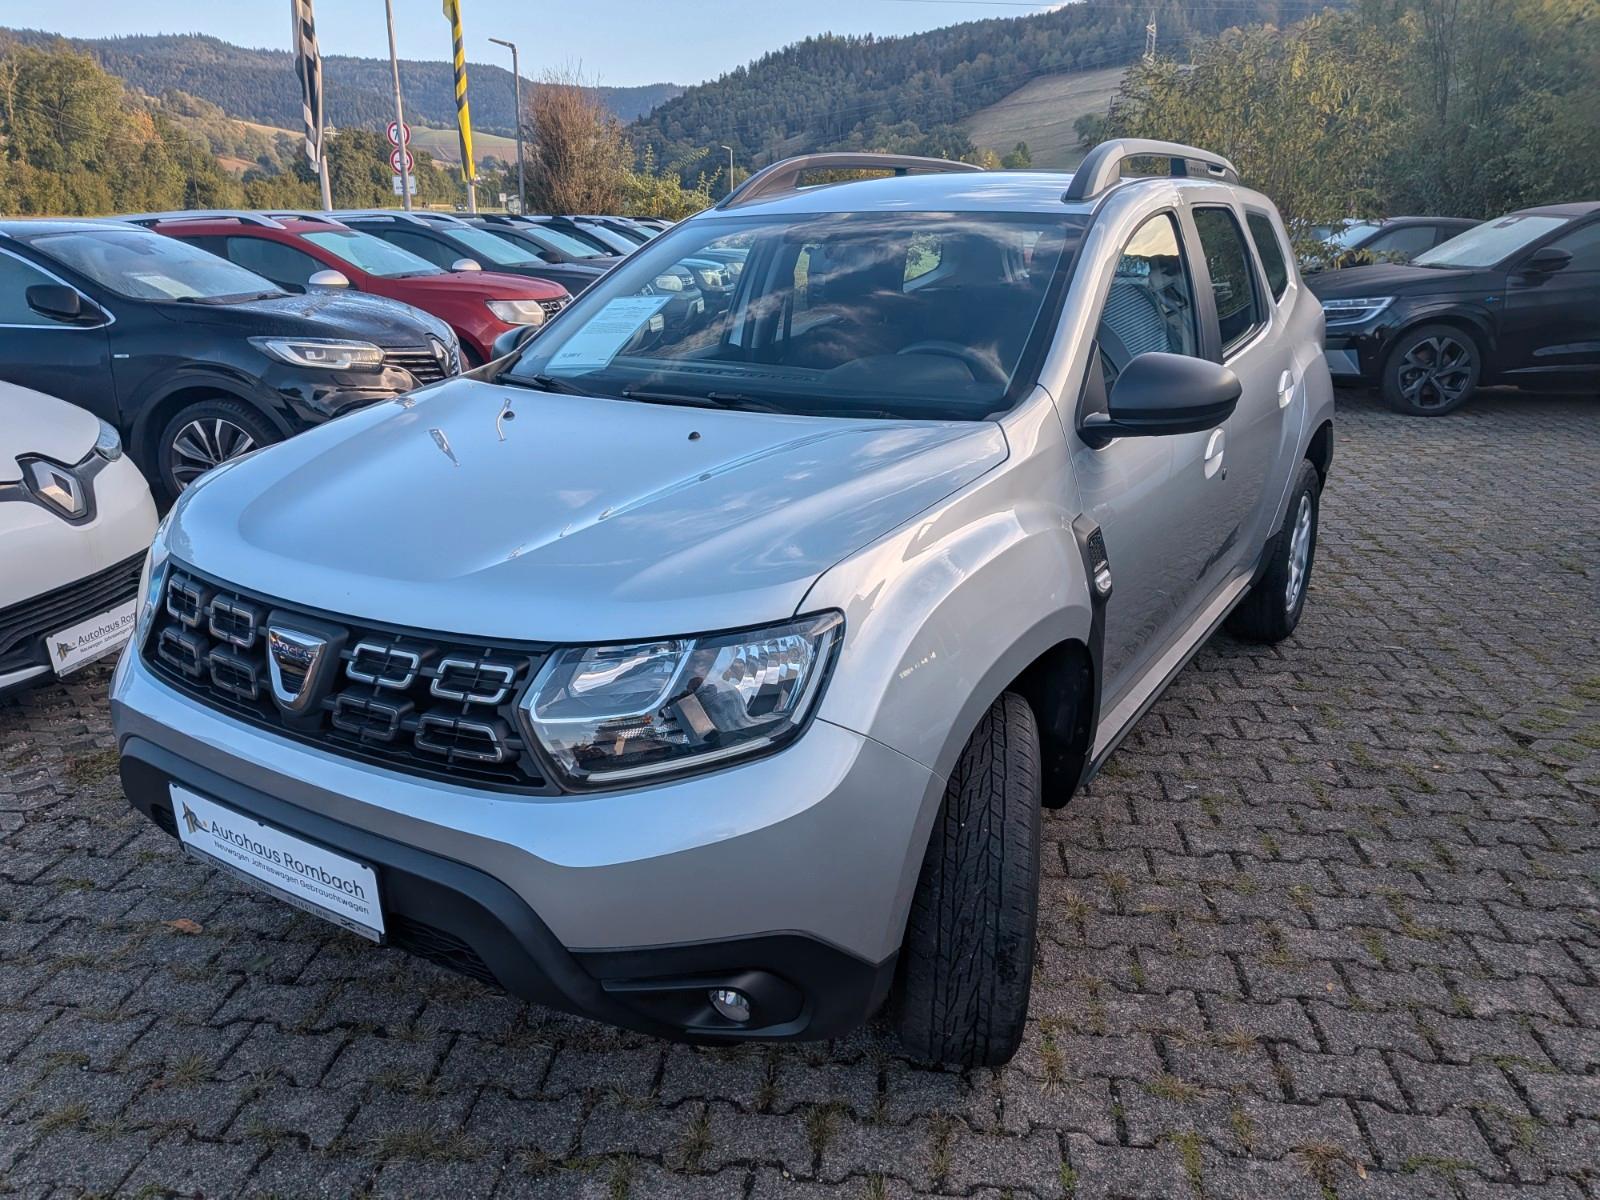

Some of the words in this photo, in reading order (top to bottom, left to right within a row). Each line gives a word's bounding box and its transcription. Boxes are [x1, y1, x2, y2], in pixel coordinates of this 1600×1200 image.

[78, 620, 120, 646] Autohaus
[211, 820, 281, 864] Autohaus
[284, 851, 366, 900] Rombach
[214, 840, 250, 863] Neuwagen
[300, 879, 370, 915] Gebrauchtwagen
